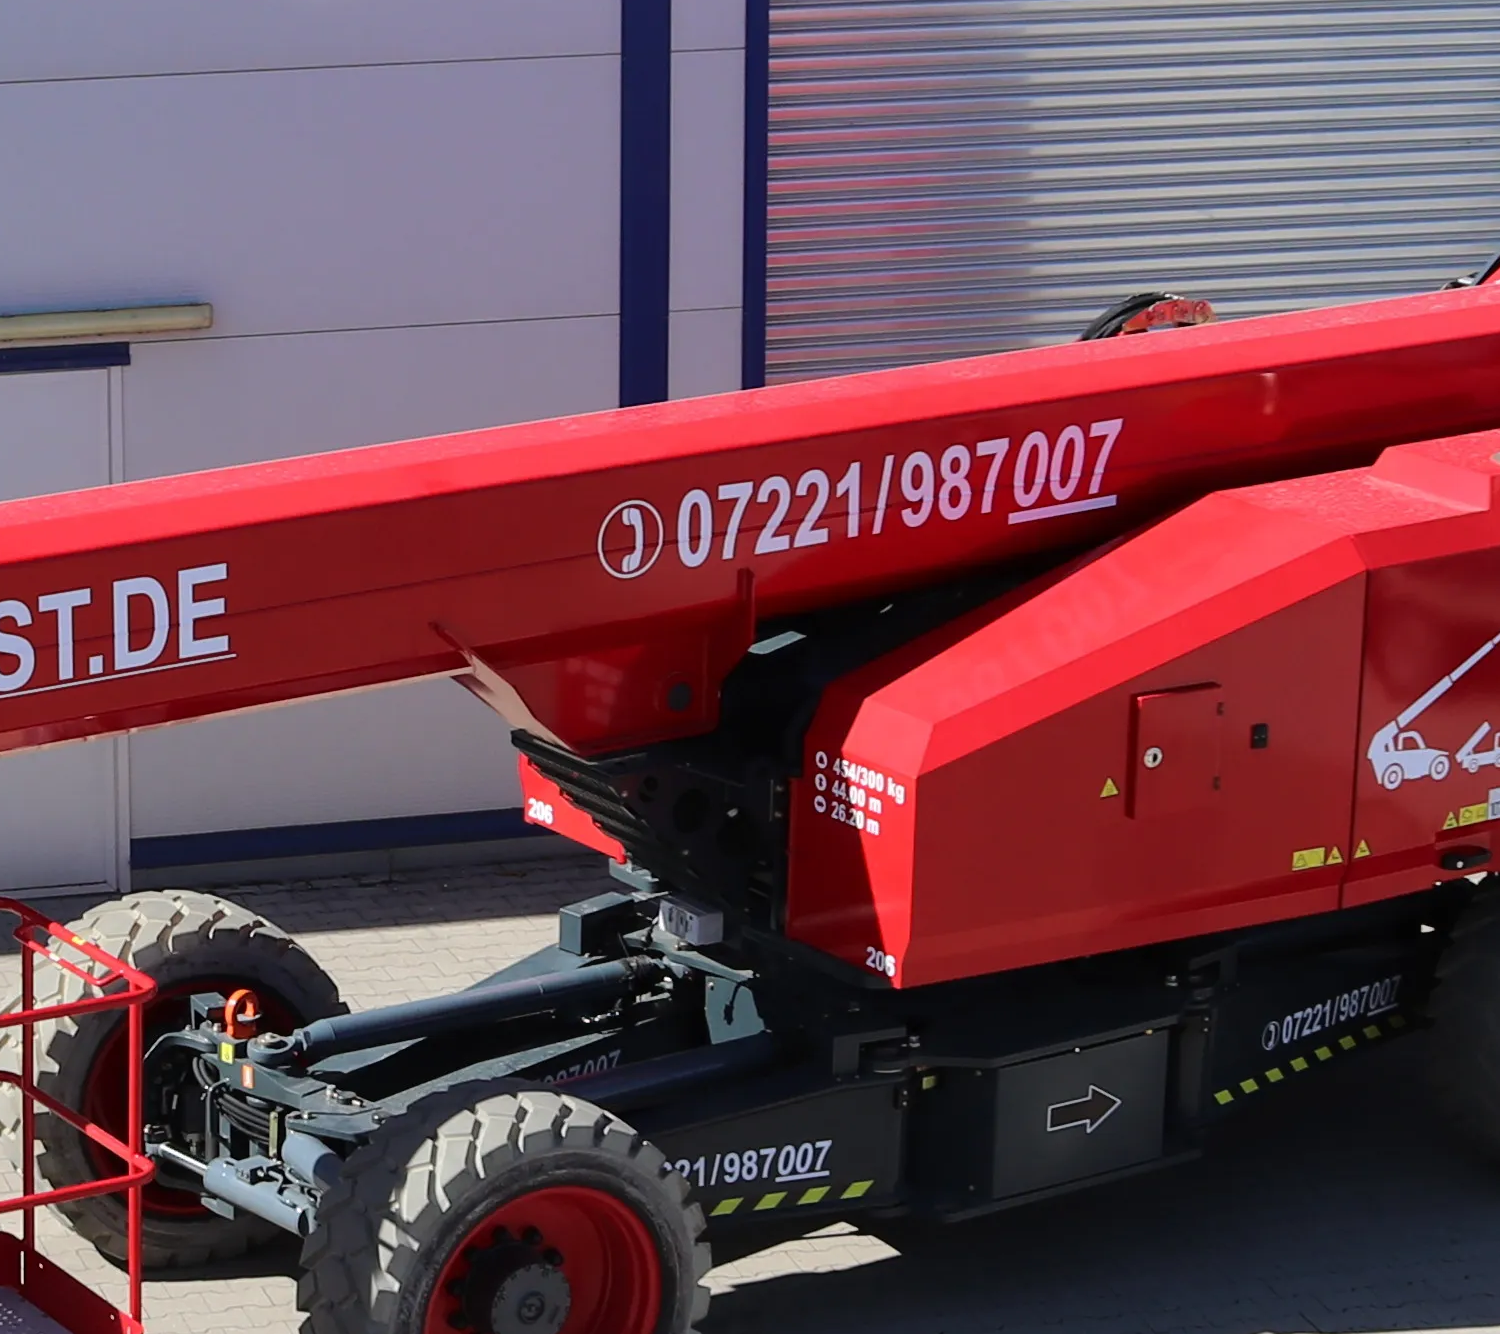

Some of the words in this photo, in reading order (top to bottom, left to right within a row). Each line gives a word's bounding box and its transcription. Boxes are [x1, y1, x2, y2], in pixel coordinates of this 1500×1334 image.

[677, 418, 1124, 569] 07221/987007
[831, 779, 866, 808] 44.00
[868, 796, 882, 814] m
[832, 757, 885, 792] 454/300
[887, 776, 906, 805] kg
[527, 797, 554, 825] 206
[830, 801, 865, 829] 26.20
[865, 818, 880, 836] m
[865, 945, 896, 977] 206
[1282, 974, 1401, 1044] 07221/987007
